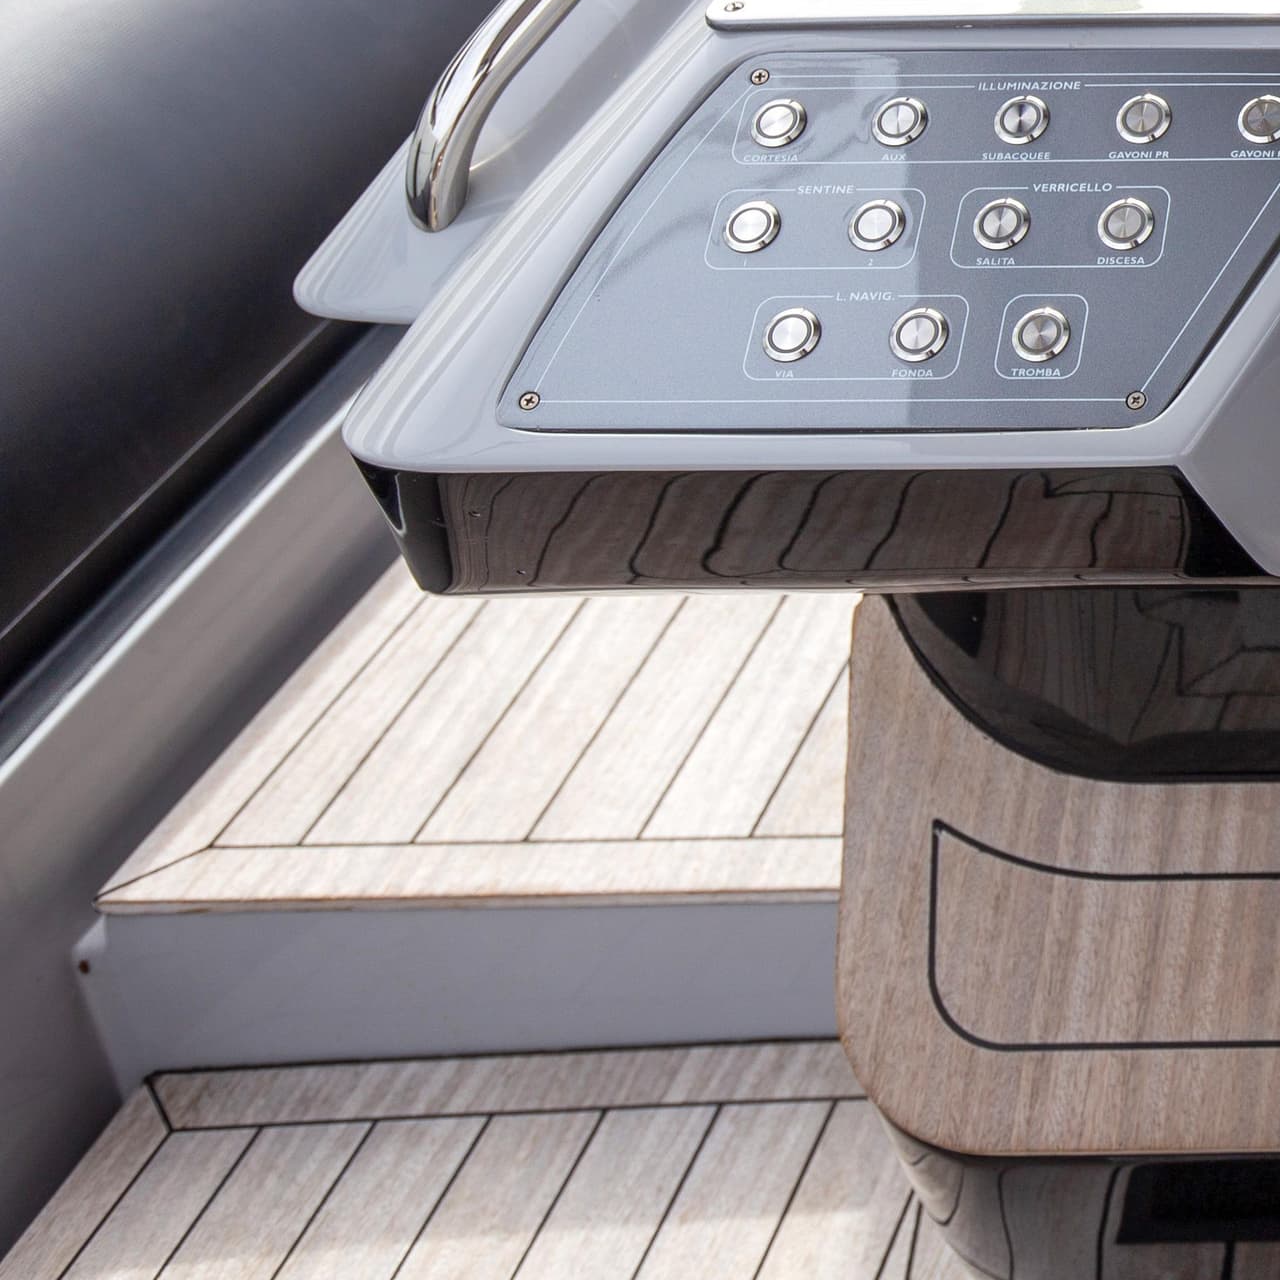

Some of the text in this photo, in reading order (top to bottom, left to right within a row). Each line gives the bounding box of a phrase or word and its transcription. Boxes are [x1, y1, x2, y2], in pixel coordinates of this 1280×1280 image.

[978, 81, 1082, 91] ILLUMINAZIONE
[743, 153, 799, 162] CORTESIA
[881, 152, 907, 161] AUX
[982, 151, 1051, 160] SUBACQUEE
[1108, 151, 1169, 159] GAVONI PR
[1230, 150, 1275, 158] GAVONI
[797, 185, 854, 194] SENTINE
[1032, 183, 1113, 192] VERRICELLO
[975, 257, 1016, 266] SALITA
[1097, 256, 1145, 265] DISCESA
[849, 291, 895, 302] NAVIG.
[775, 370, 794, 378] VIA
[892, 369, 933, 377] FONDA
[1010, 368, 1061, 377] TROMBA
